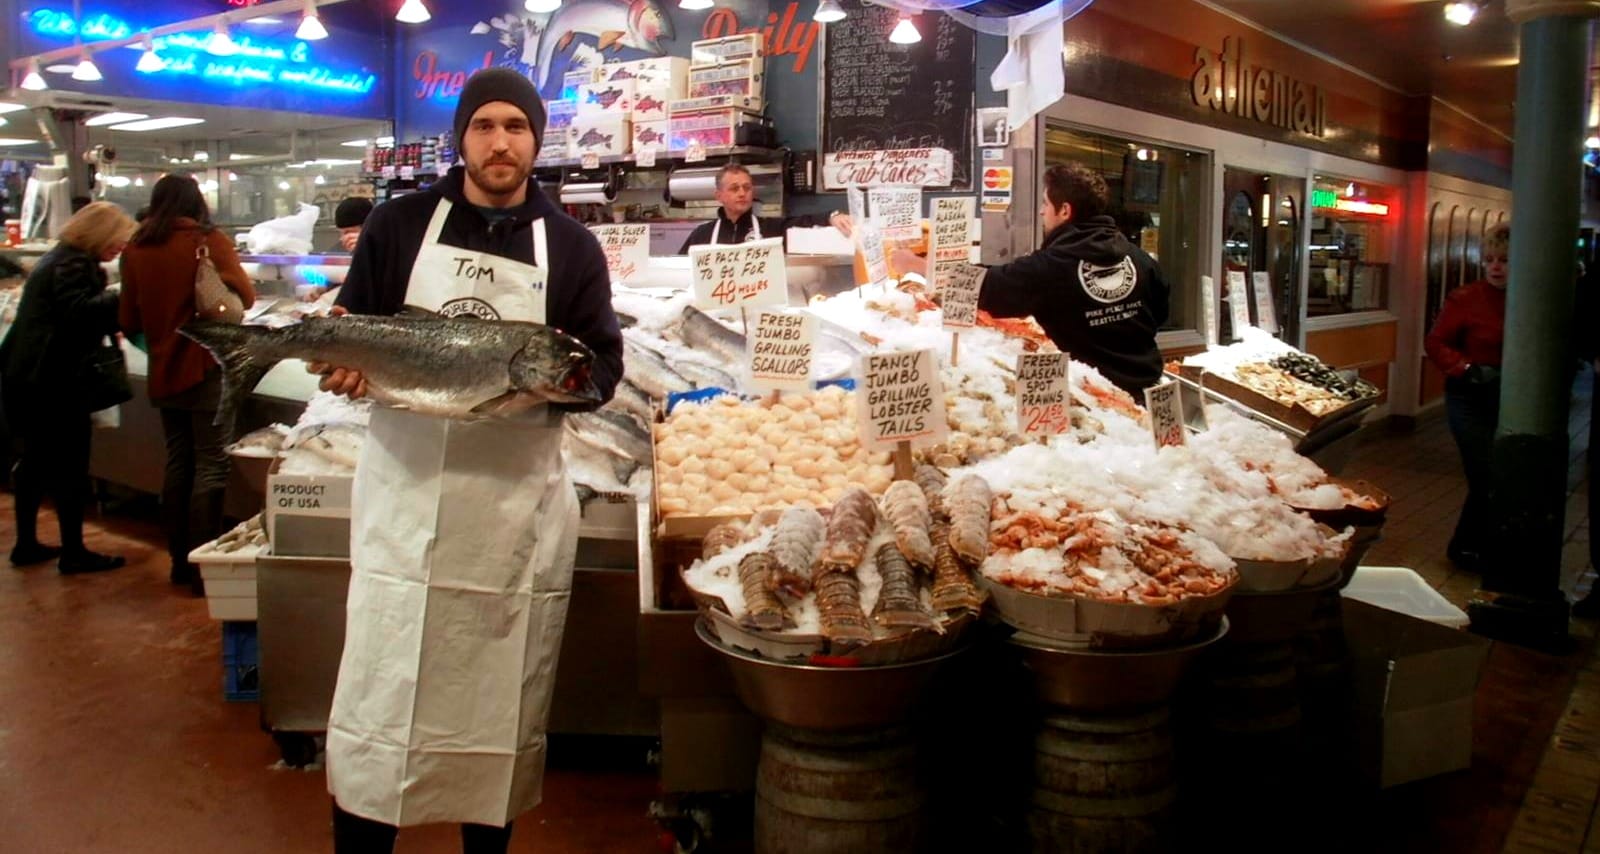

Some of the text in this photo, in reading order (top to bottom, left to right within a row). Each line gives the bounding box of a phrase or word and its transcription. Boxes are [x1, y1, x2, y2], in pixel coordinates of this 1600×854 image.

[704, 2, 819, 73] Dily
[1190, 35, 1326, 138] athenian
[697, 247, 770, 267] WE PACK FISH
[699, 267, 713, 281] TO
[741, 261, 766, 277] FOR
[711, 279, 737, 305] 48
[472, 302, 496, 320] FOO
[760, 313, 804, 328] FRESH
[755, 327, 801, 341] JUMBO
[754, 341, 812, 357] GRILLING
[751, 356, 811, 376] SCALLOPS
[869, 350, 923, 371] FANCY
[1022, 354, 1062, 368] FRESH
[866, 369, 920, 389] JUMBO
[1017, 366, 1065, 382] ALASKAN
[868, 383, 930, 405] GRILLING
[1026, 379, 1054, 394] SPOT
[1022, 390, 1064, 406] PRAWNS
[870, 398, 933, 420] LOBSTER
[877, 416, 925, 436] TAILS
[273, 484, 326, 496] PRODUCT
[278, 497, 321, 509] OF USA
